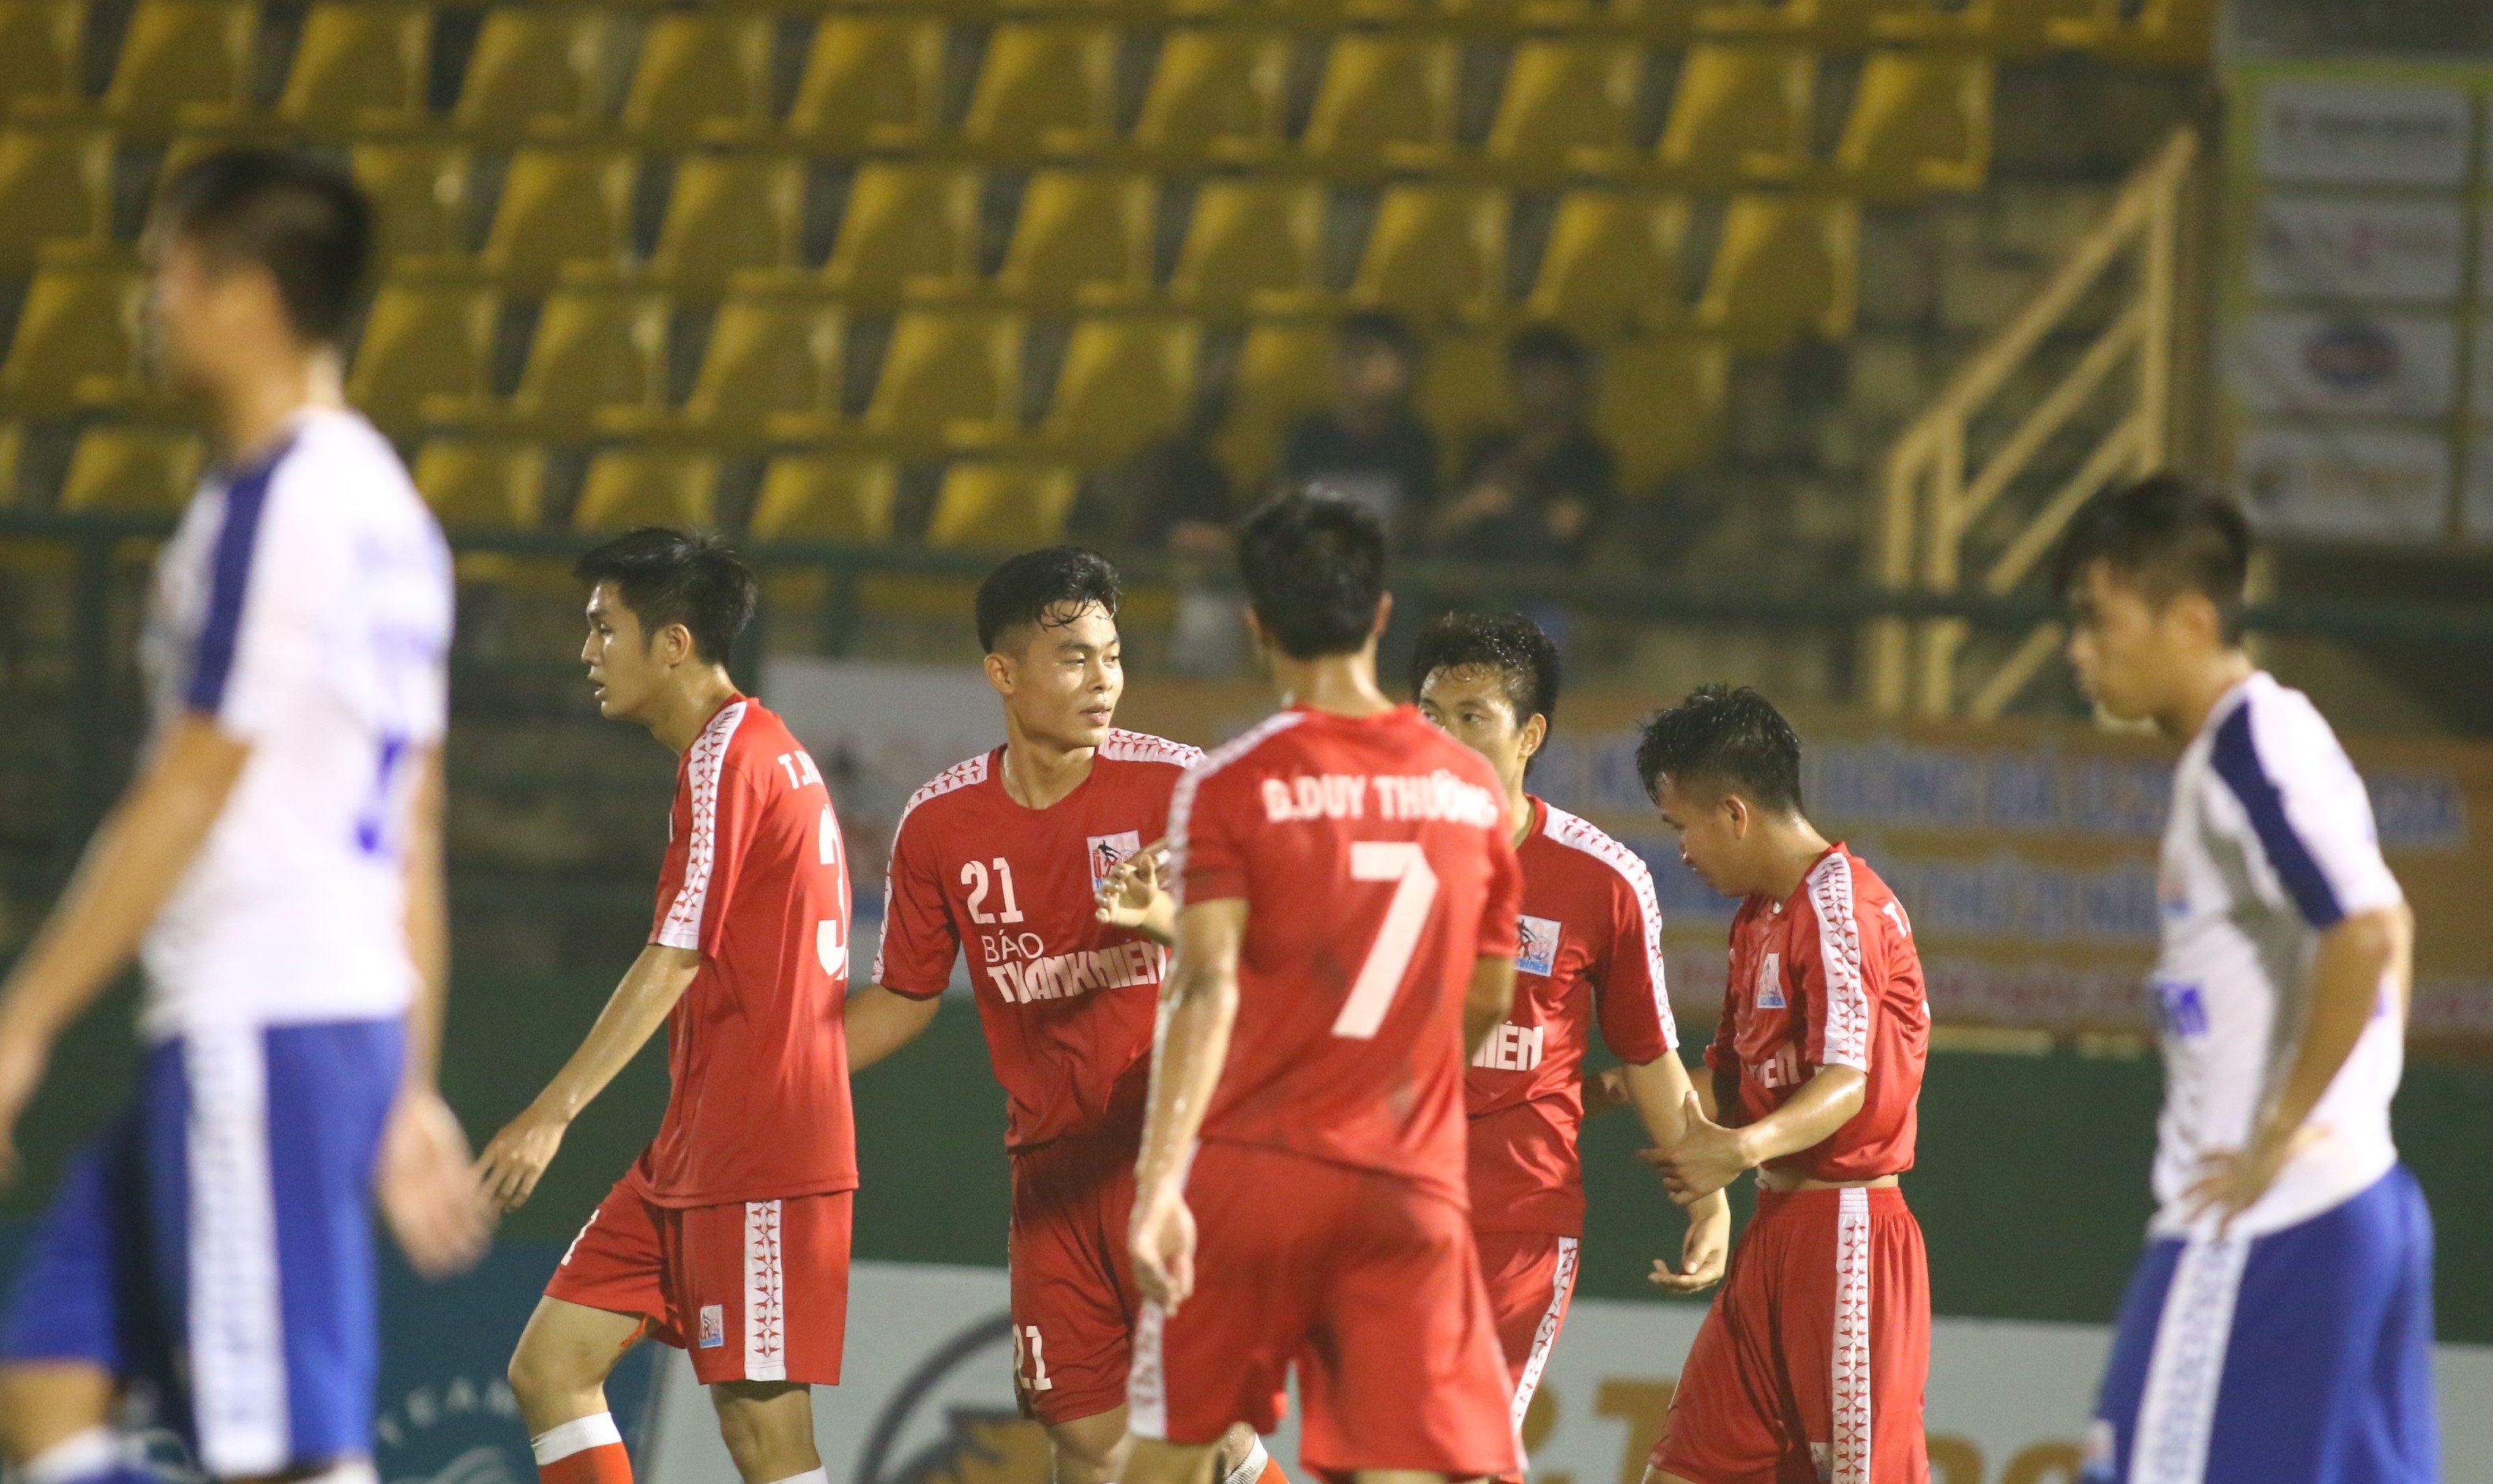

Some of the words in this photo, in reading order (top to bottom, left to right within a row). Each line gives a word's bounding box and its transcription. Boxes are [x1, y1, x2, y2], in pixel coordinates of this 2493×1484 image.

[960, 857, 1024, 924] 21
[981, 929, 1044, 963] BÁO
[1331, 840, 1439, 1039] 7
